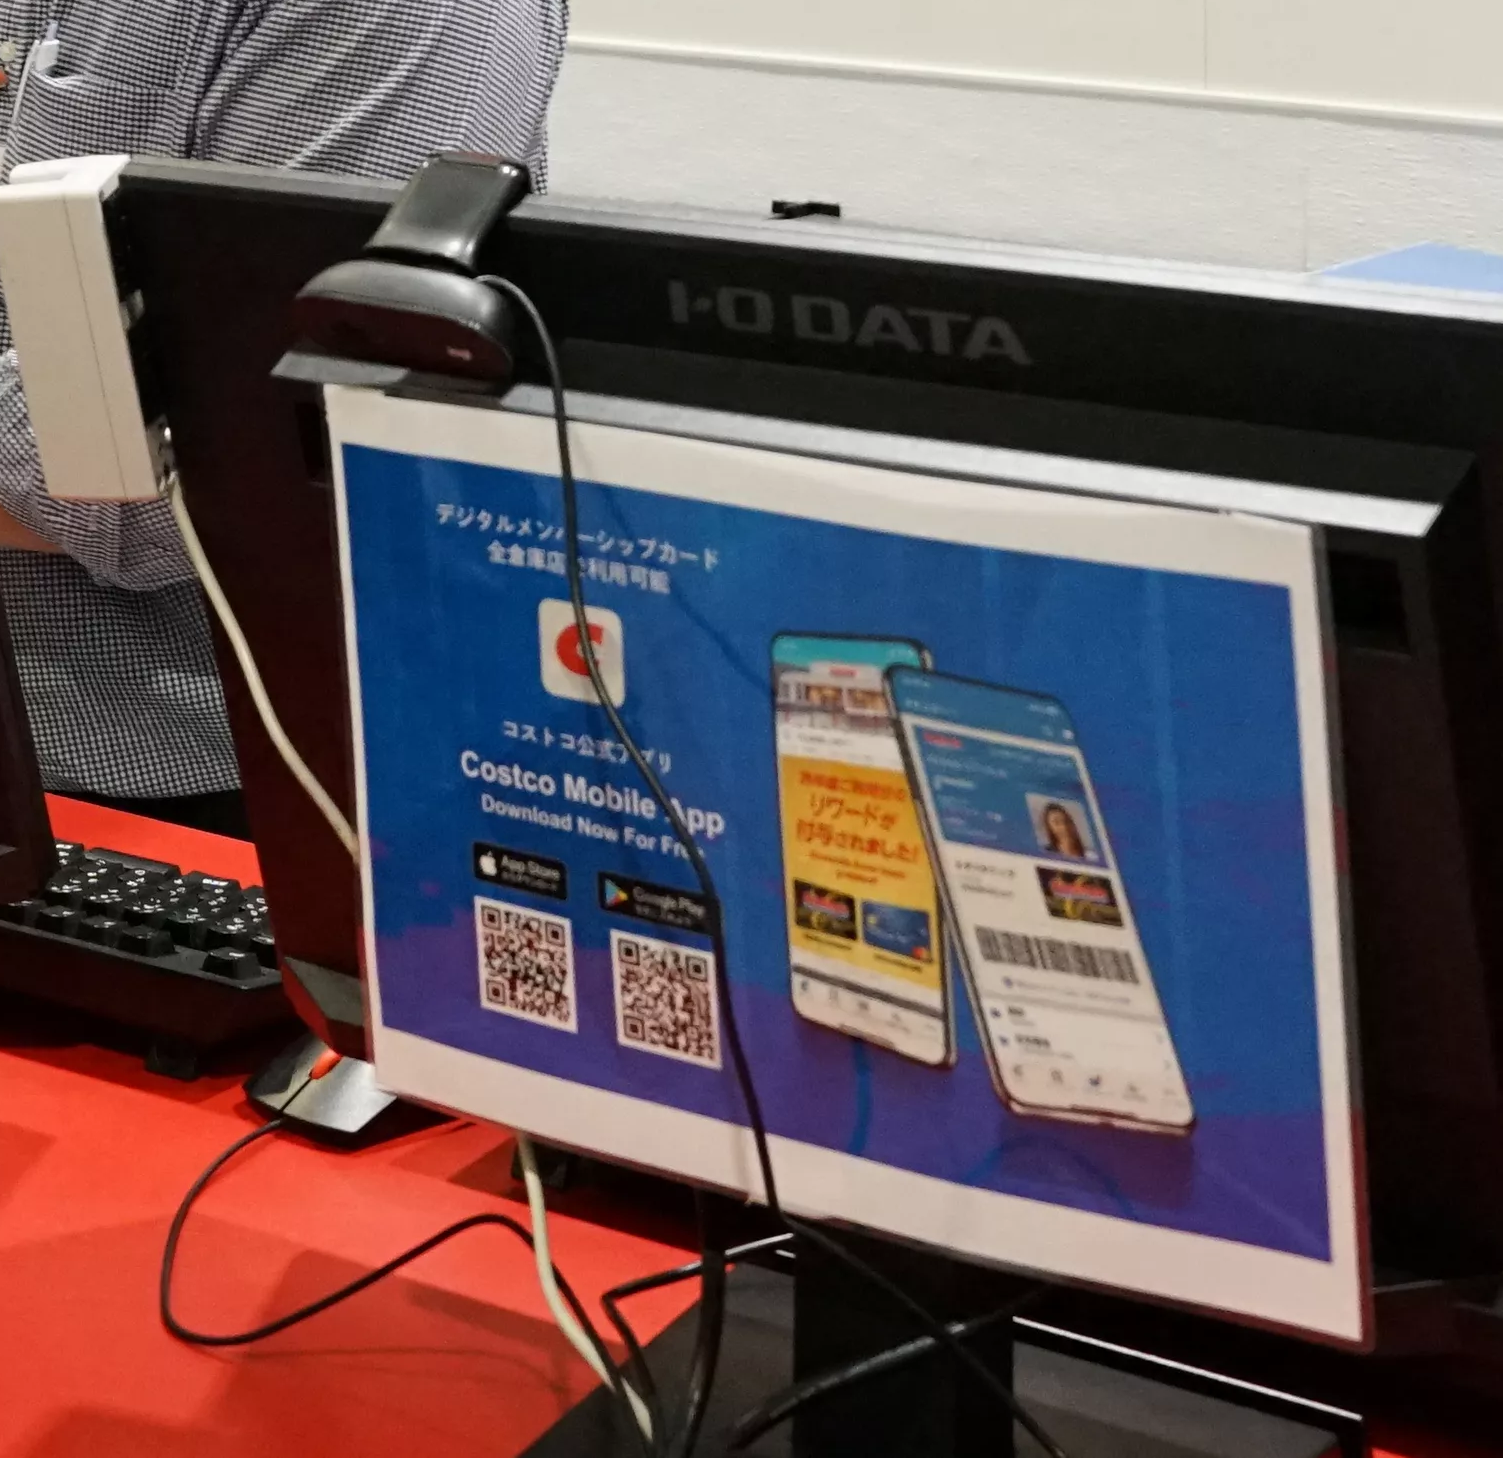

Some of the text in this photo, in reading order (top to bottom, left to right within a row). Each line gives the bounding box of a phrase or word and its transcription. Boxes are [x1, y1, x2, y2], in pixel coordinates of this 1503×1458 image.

[789, 293, 1033, 367] DATA
[460, 749, 556, 796] Costco
[563, 773, 656, 820] Mobile
[481, 793, 573, 833] Download
[576, 816, 620, 843] Now
[624, 826, 656, 851] For
